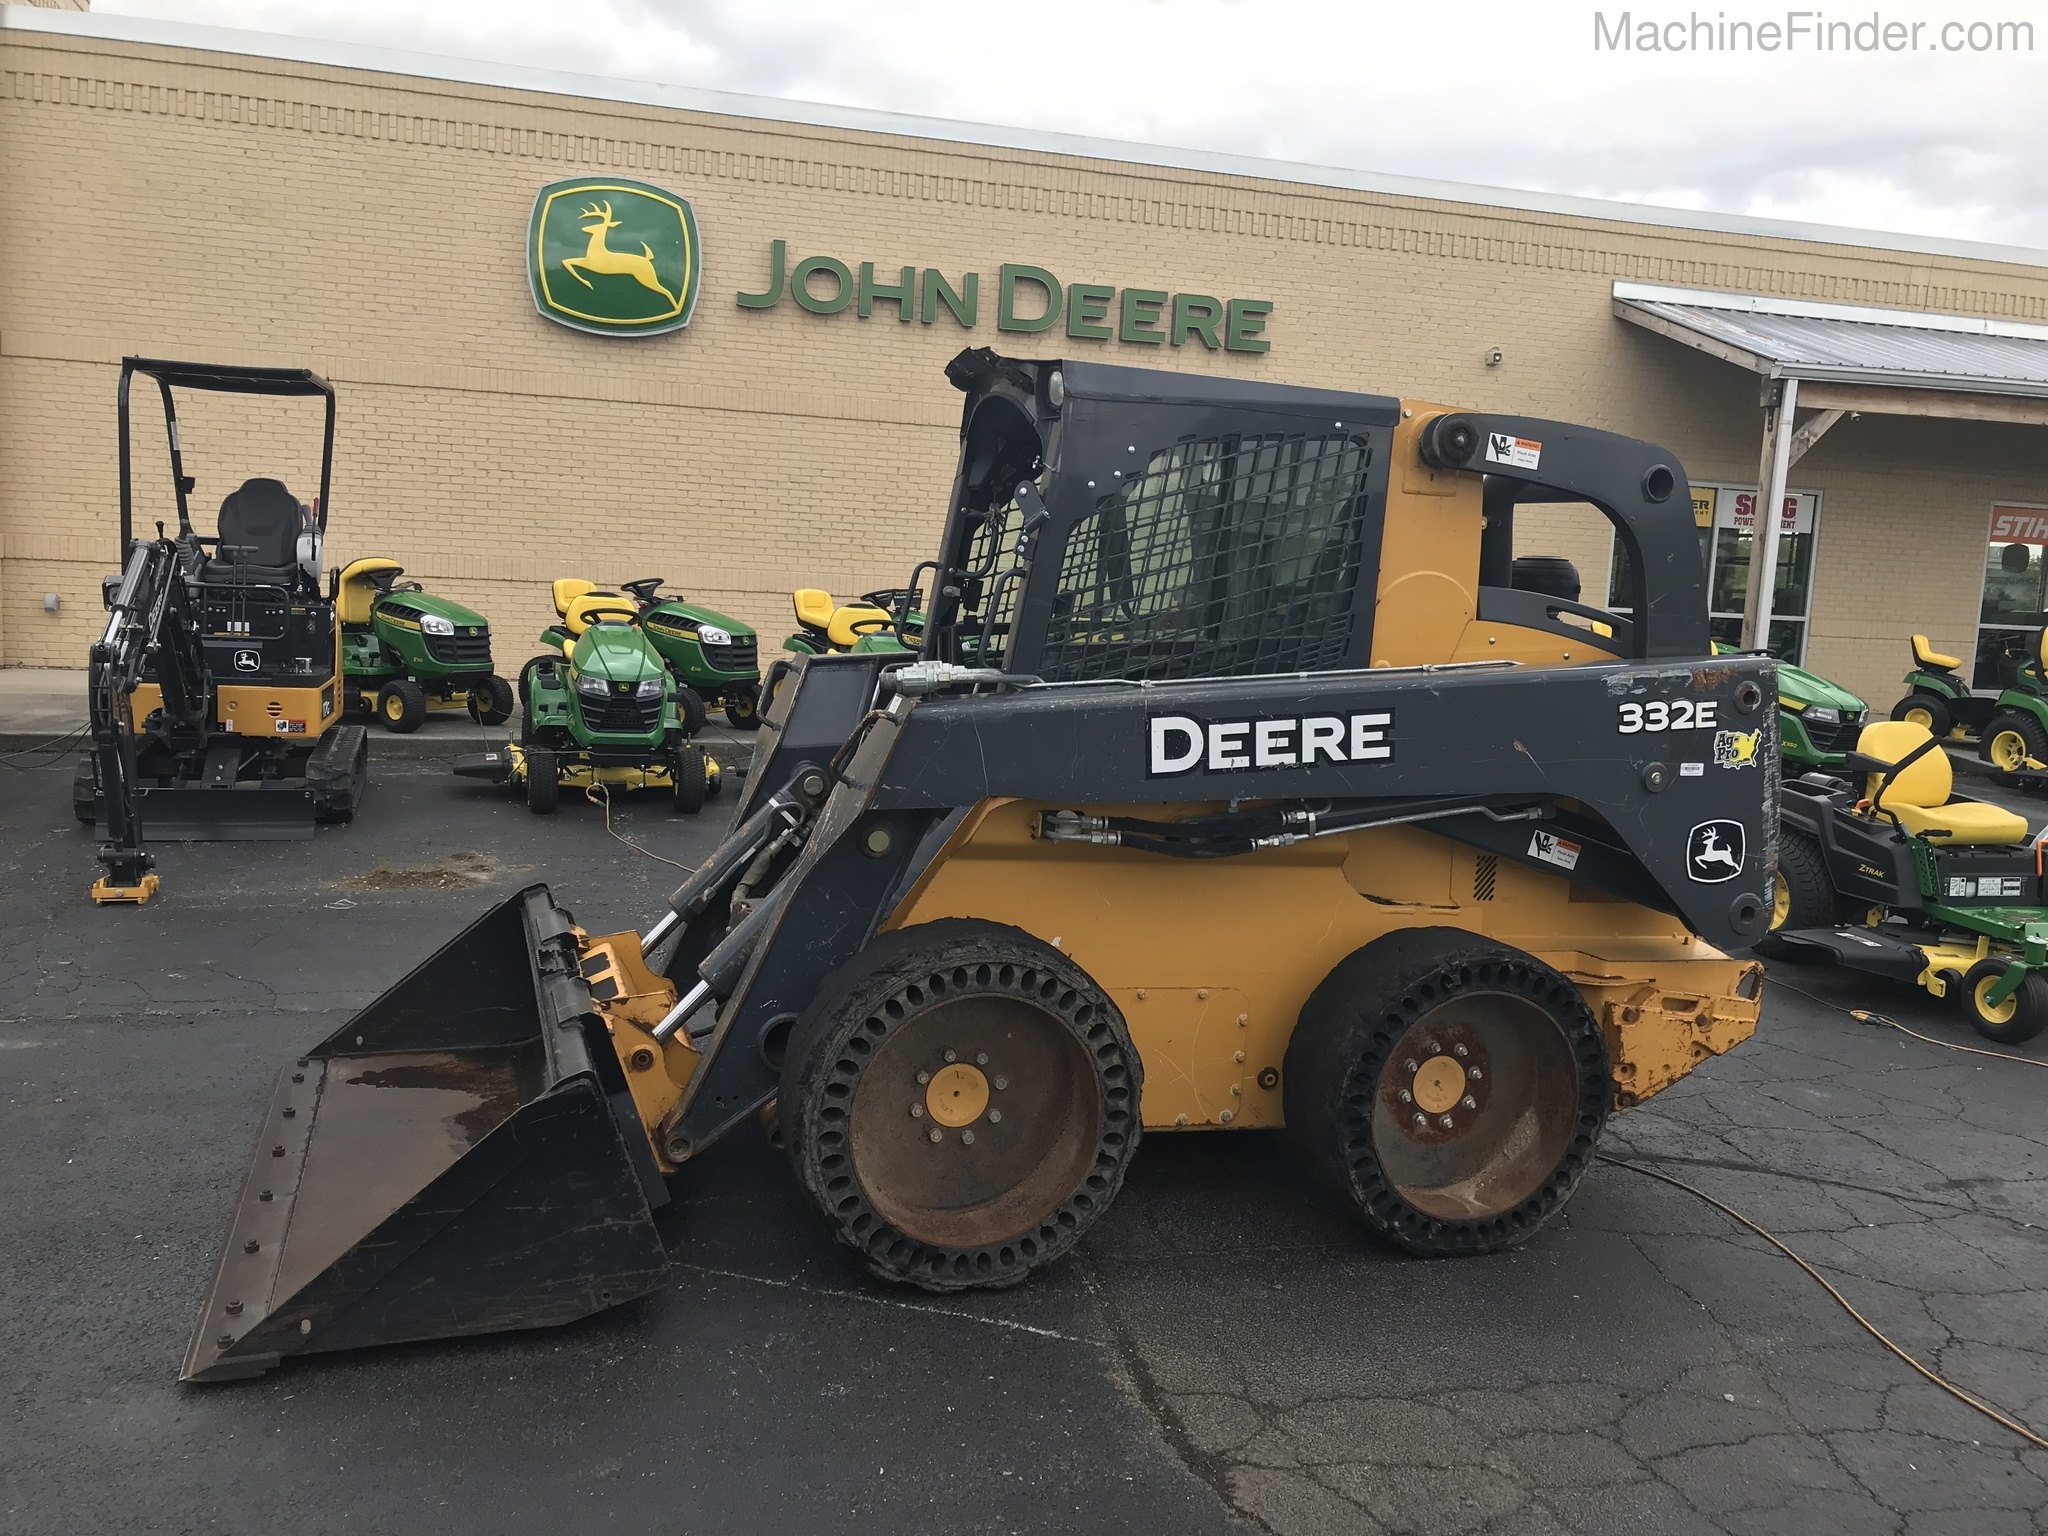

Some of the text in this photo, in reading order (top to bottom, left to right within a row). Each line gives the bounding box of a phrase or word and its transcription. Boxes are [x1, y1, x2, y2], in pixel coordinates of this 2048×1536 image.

[735, 238, 1274, 353] JOHN DEERE
[1520, 440, 1540, 449] WARNING
[1735, 493, 1798, 519] SG
[1734, 516, 1755, 527] POWE
[1992, 515, 2048, 539] STIH
[1618, 700, 1718, 733] 332E
[1150, 712, 1392, 774] DEERE
[1716, 733, 1739, 749] Ag-
[1716, 748, 1739, 761] Pro
[1858, 863, 1885, 878] ZTRAK
